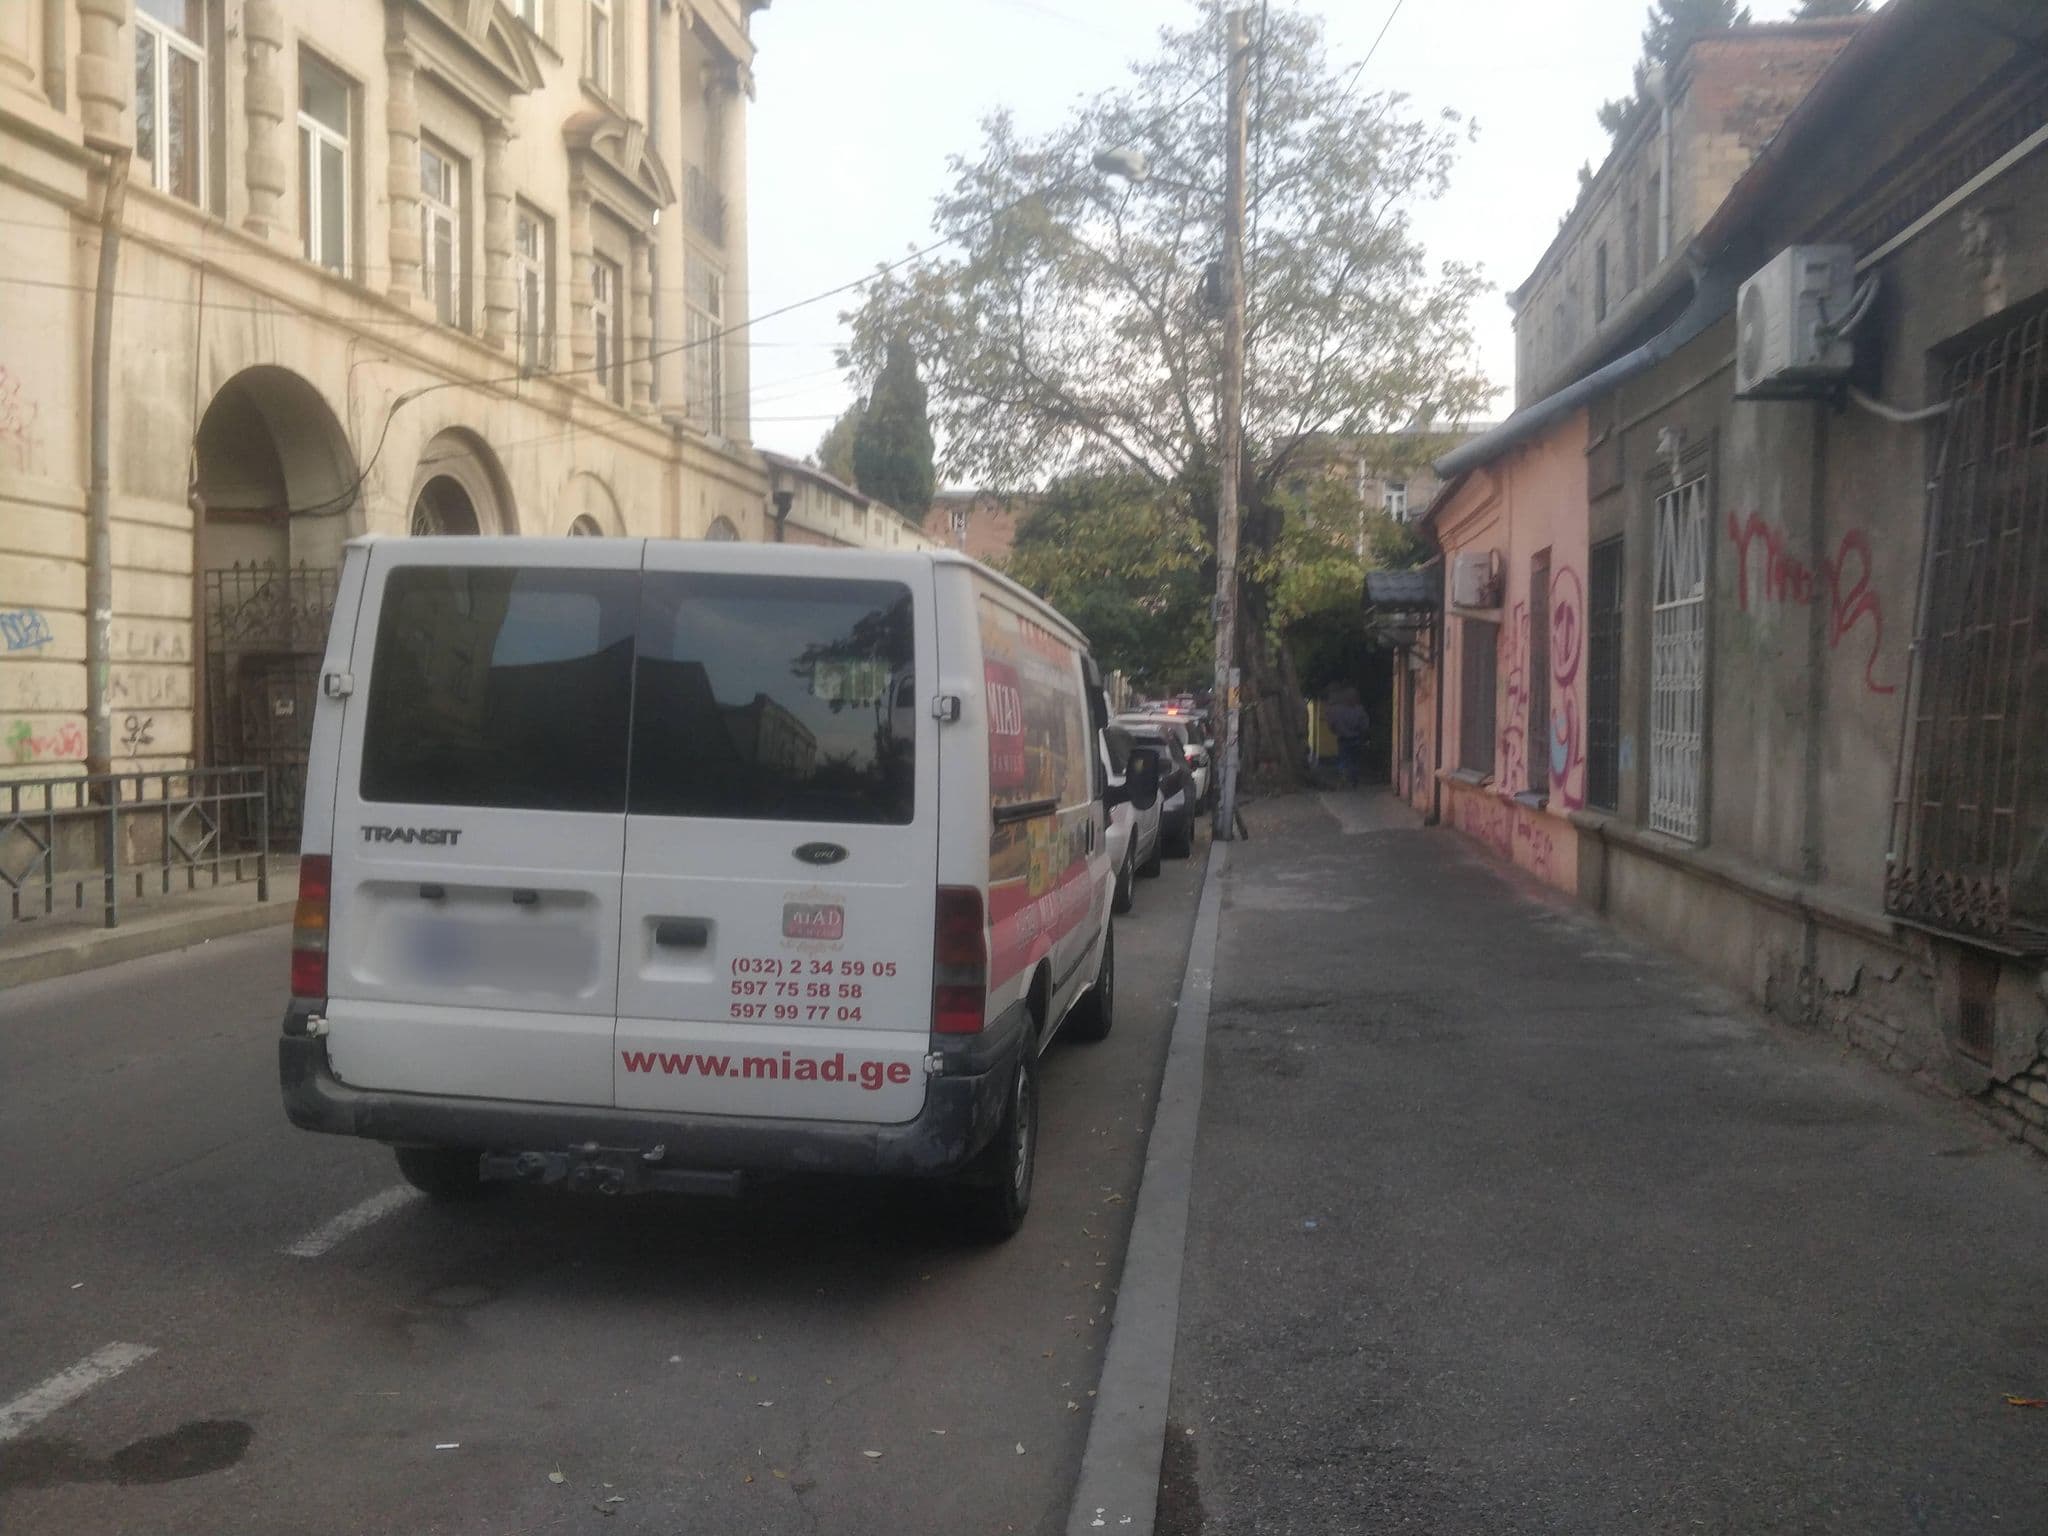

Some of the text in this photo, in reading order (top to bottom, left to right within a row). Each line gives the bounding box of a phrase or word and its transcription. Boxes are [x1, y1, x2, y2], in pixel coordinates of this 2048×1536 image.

[361, 826, 462, 845] TRANSIT
[731, 958, 897, 977] (032) 2 34 59 05
[731, 980, 863, 999] 597 75 58 58
[730, 1003, 862, 1022] 597 99 77 04
[621, 1050, 911, 1091] www.miad.ge
